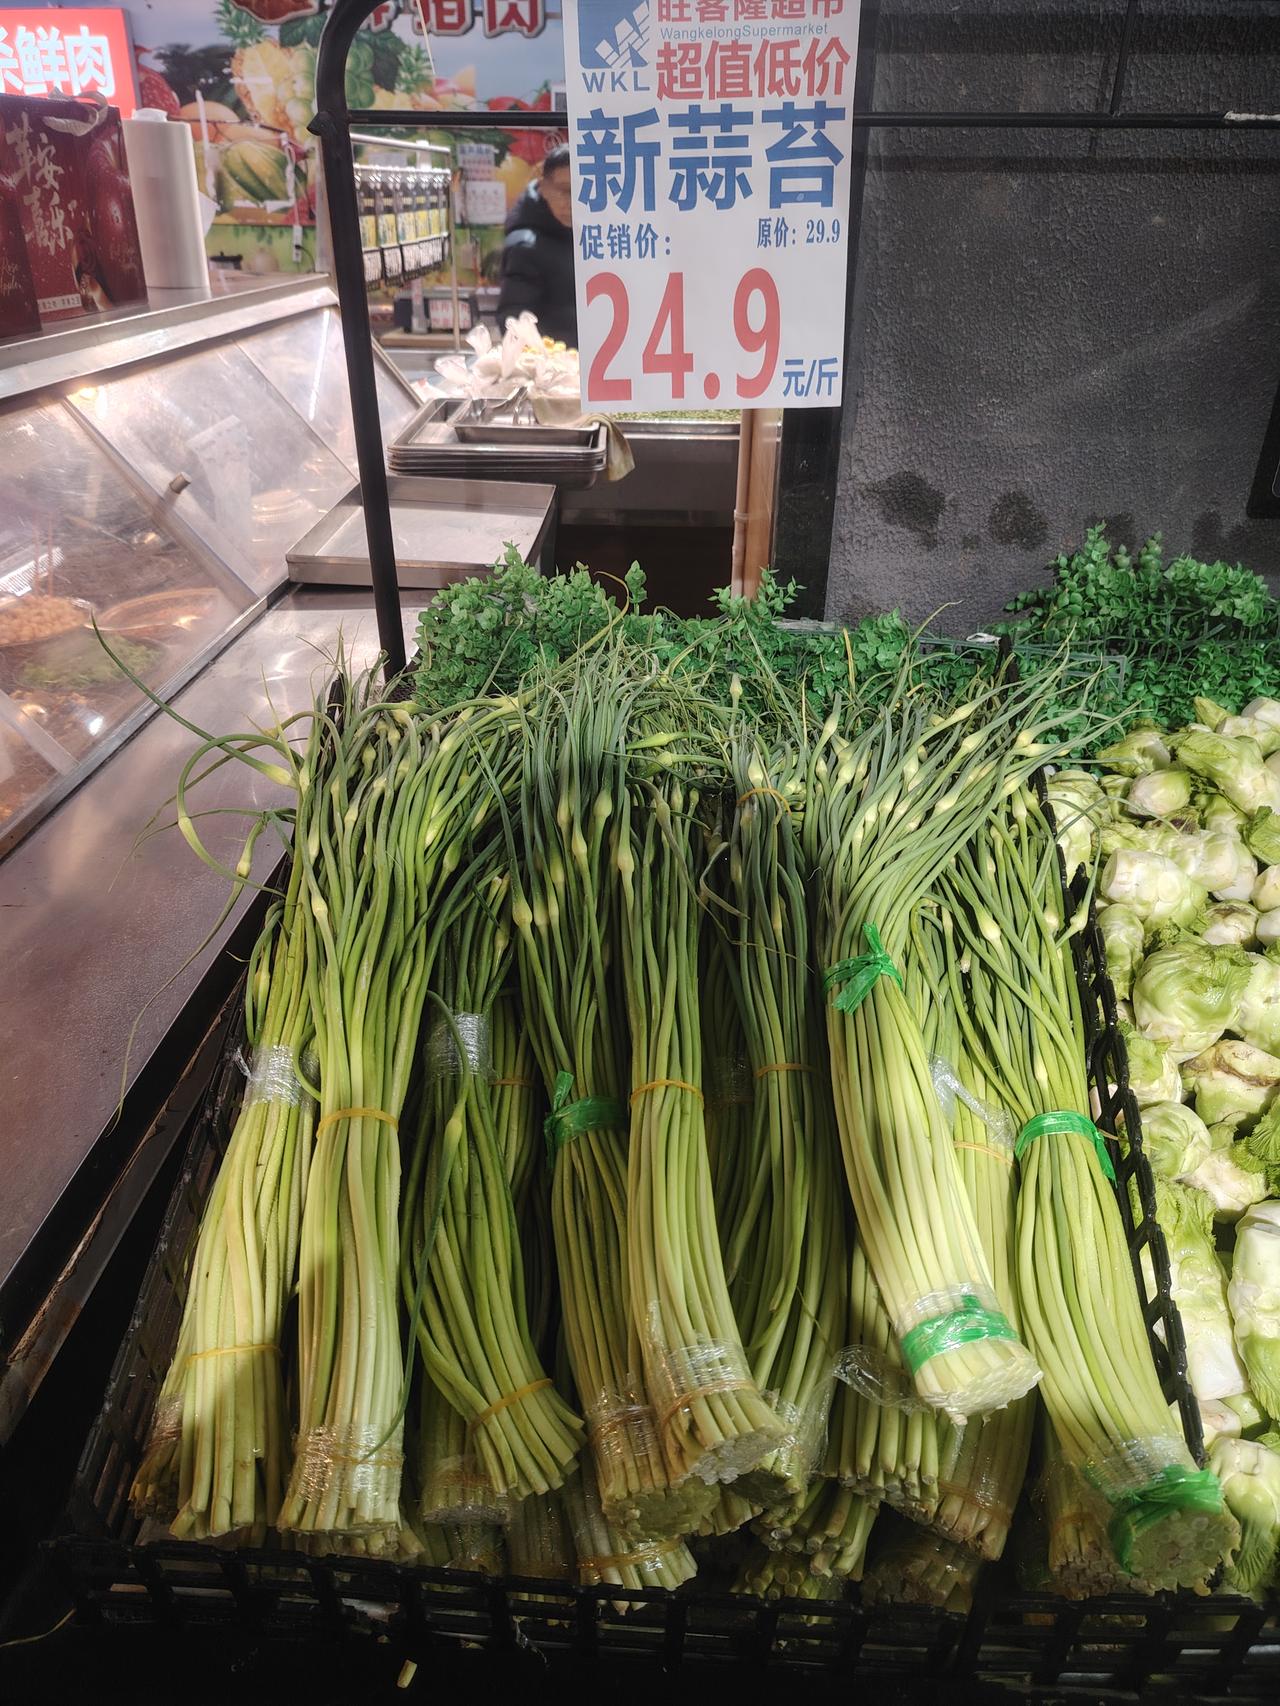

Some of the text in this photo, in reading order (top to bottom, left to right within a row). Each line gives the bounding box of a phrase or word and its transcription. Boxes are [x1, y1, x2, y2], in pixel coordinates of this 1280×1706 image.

[660, 23, 829, 41] WangkelongSupermarket
[582, 71, 650, 93] WKL
[656, 37, 851, 101] 超值低价
[576, 100, 846, 214] 新蒜苔
[579, 223, 671, 261] 促销价：
[586, 267, 839, 402] 24.9 元/斤
